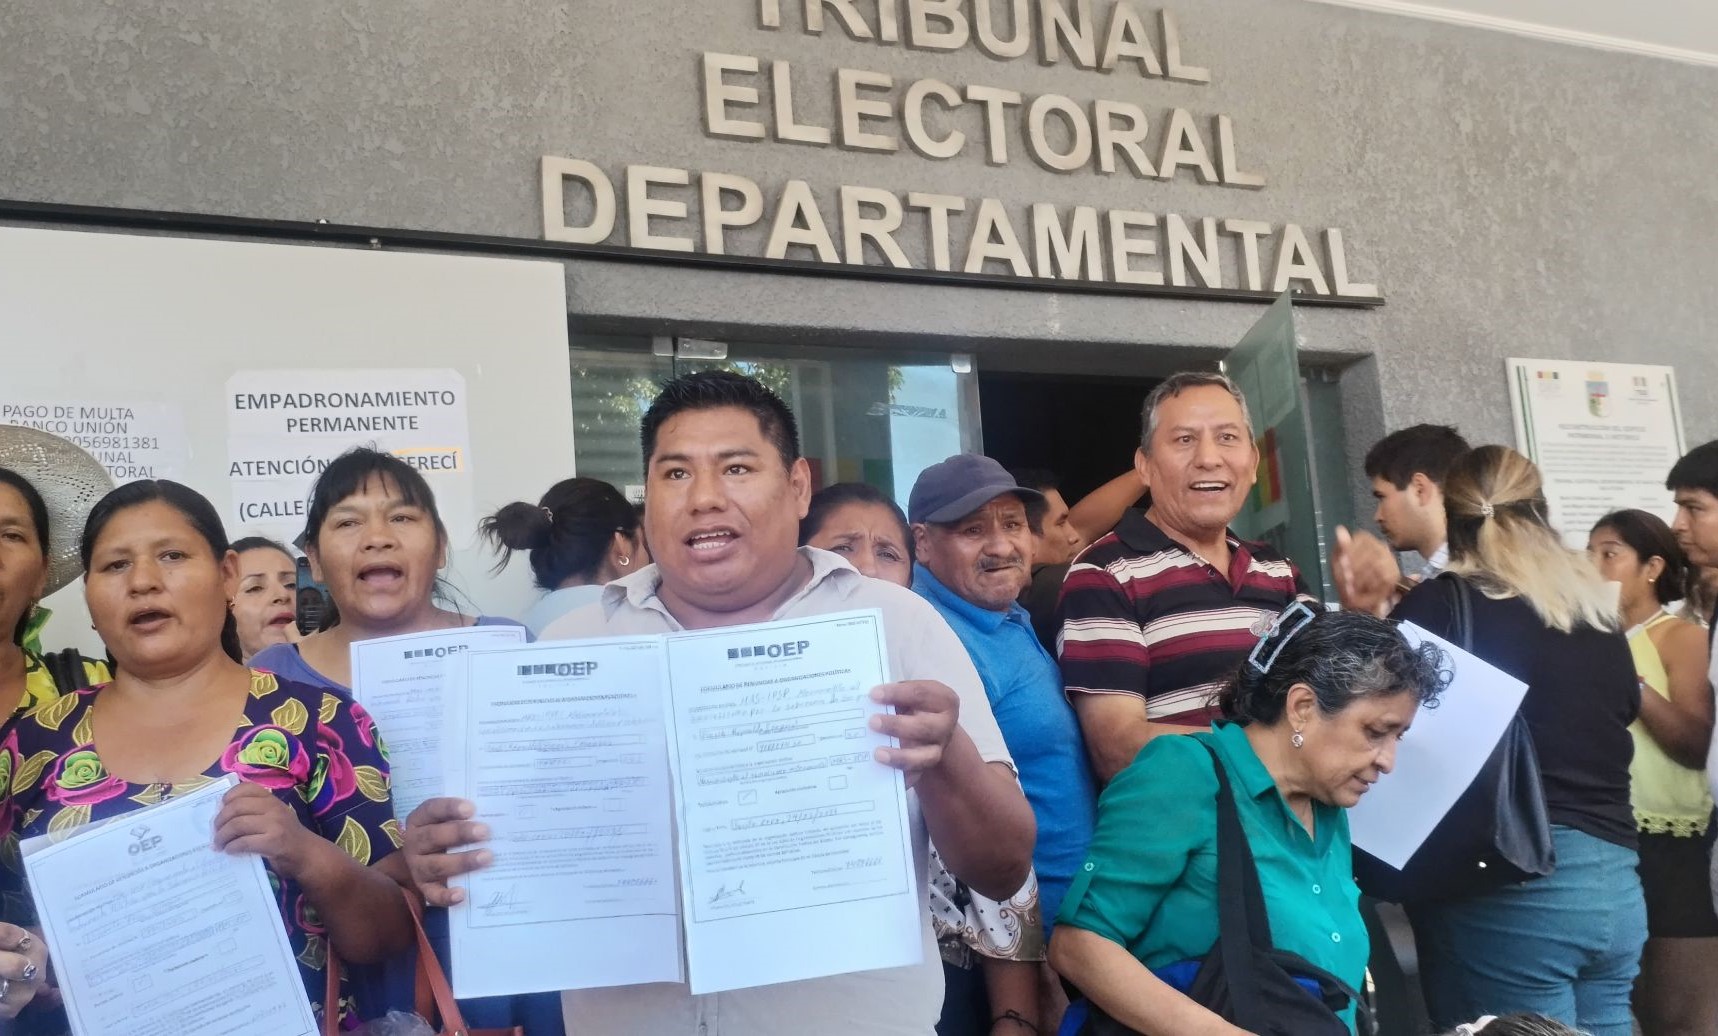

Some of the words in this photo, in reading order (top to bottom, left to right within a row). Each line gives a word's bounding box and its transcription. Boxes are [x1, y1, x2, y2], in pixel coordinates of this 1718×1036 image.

[702, 50, 1266, 189] ELECTORAL
[541, 155, 1379, 298] DEPARTAMENTAL
[234, 389, 456, 411] EMPADRONAMIENTO
[3, 404, 48, 418] PAGO
[54, 406, 75, 419] DE
[80, 407, 135, 421] MULTA
[74, 419, 128, 434] UNIÓN
[286, 415, 419, 434] PERMANENTE
[64, 436, 160, 450] 056981381
[229, 454, 331, 477] ATENCIÓN
[239, 500, 304, 523] (CALLE
[767, 640, 810, 658] OEP
[554, 661, 598, 677] OEP
[127, 835, 163, 856] OEP
